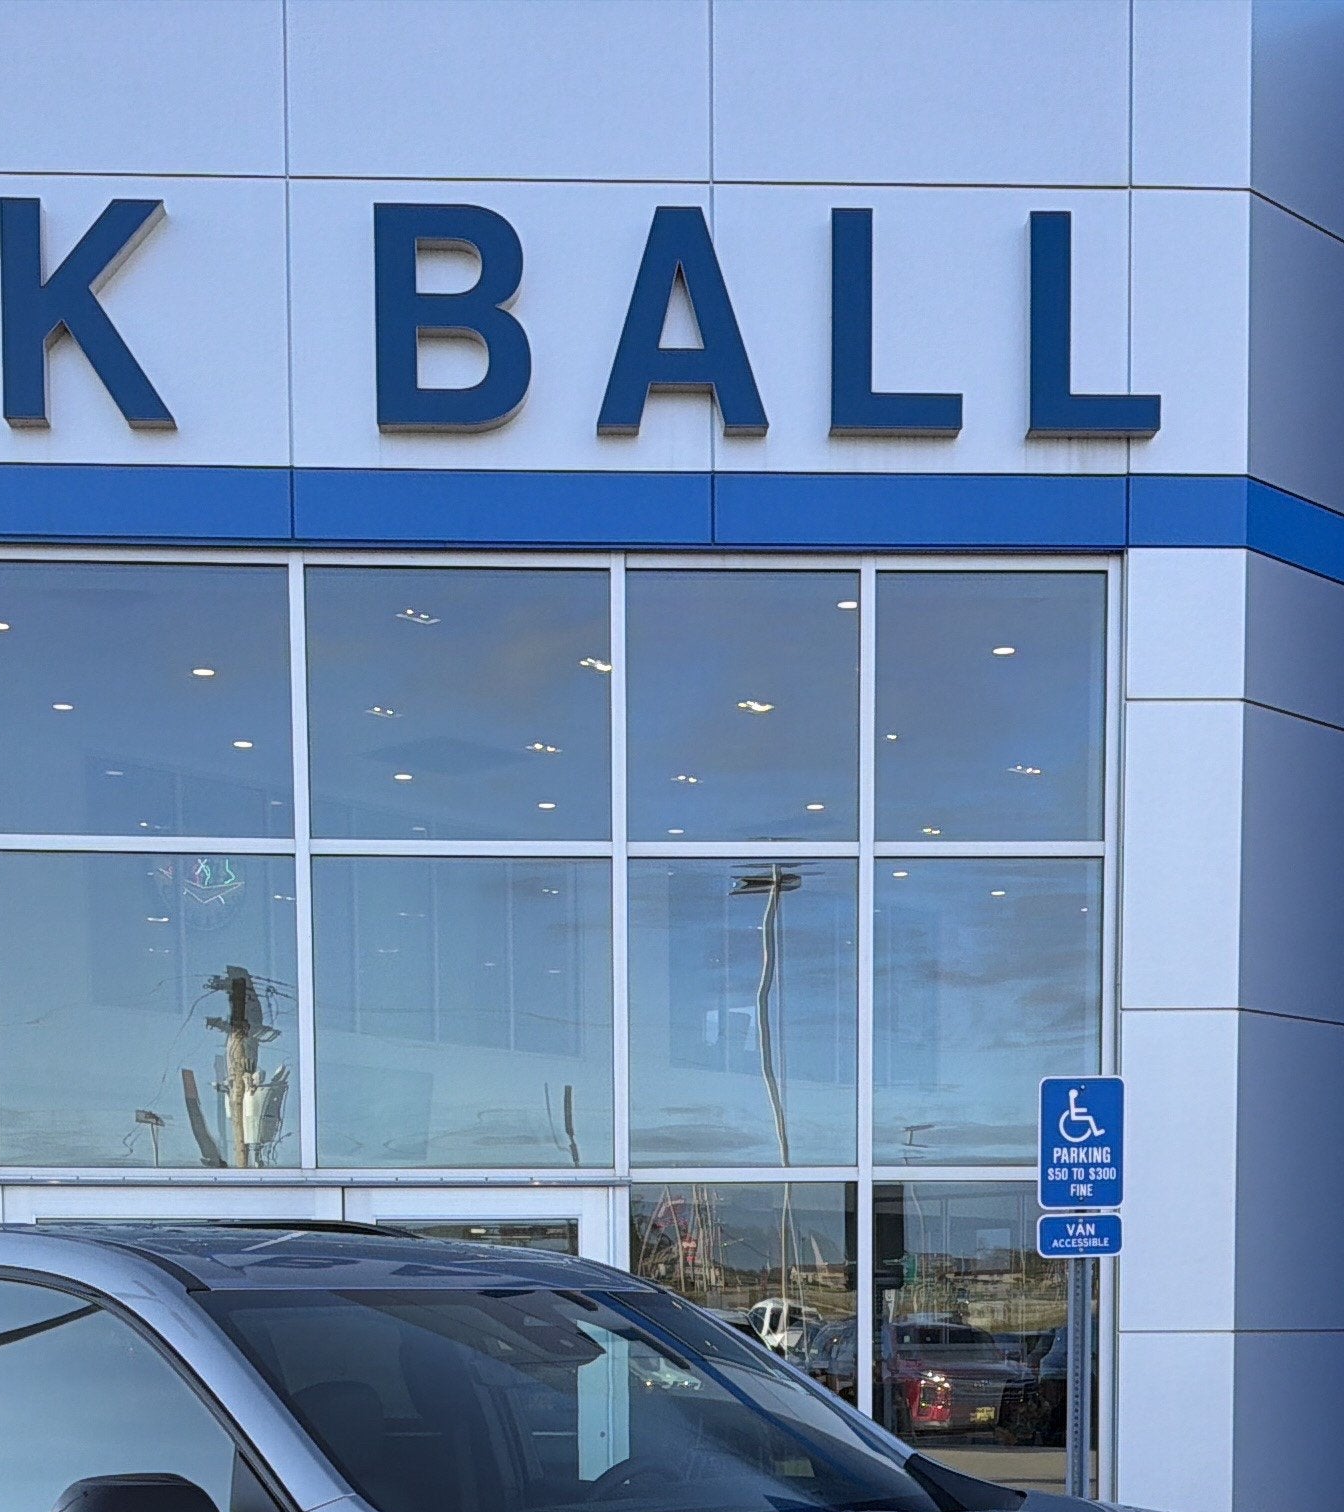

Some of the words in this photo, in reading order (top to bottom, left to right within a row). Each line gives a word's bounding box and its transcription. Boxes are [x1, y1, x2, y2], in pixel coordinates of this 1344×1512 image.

[372, 201, 1163, 440] BALL
[1053, 1146, 1111, 1164] PARKING
[1047, 1166, 1068, 1181] $50
[1071, 1166, 1084, 1180] TO
[1088, 1166, 1117, 1181] $300
[1070, 1183, 1094, 1197] FINE
[1066, 1222, 1096, 1236] VAN
[1051, 1237, 1110, 1248] ACCESSIBLE
